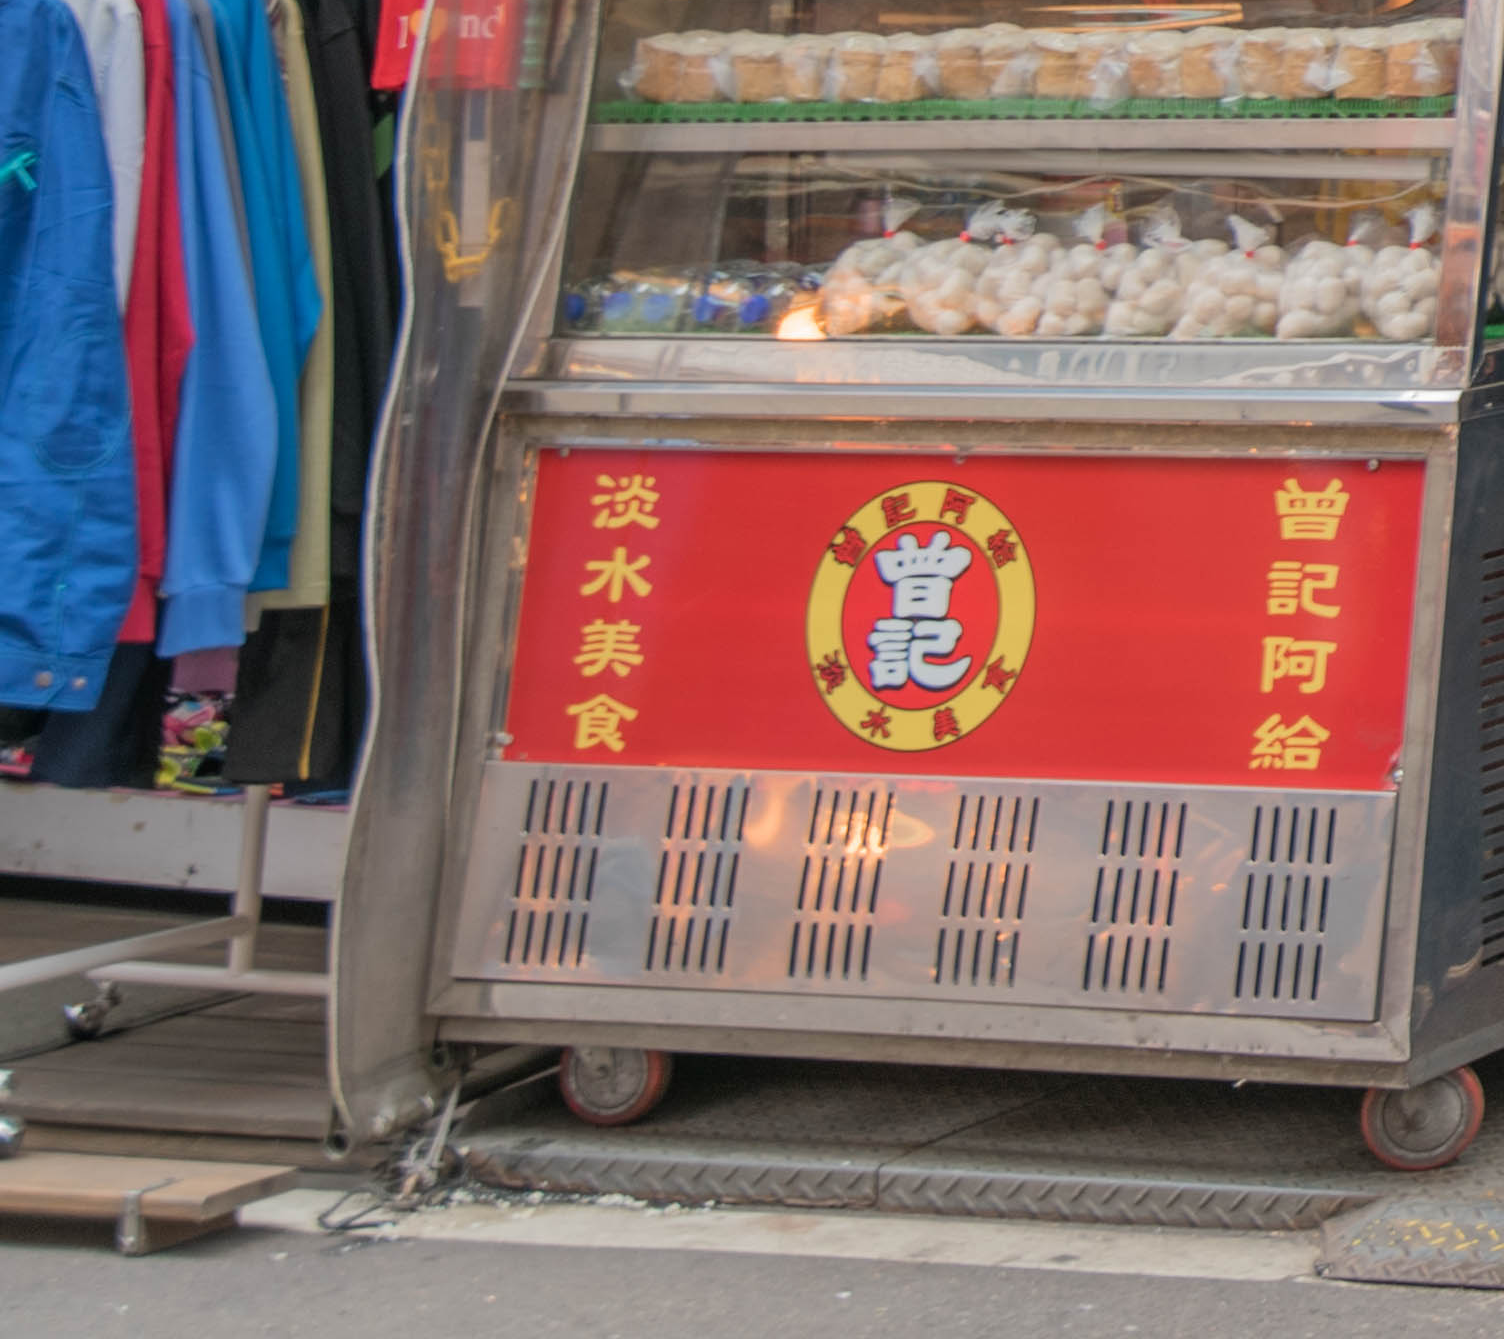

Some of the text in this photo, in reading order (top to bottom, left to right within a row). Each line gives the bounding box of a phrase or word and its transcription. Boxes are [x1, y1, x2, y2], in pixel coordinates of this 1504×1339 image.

[566, 473, 660, 754] 淡水美食
[867, 530, 972, 691] 曾記
[1248, 479, 1351, 771] 曾記阿給
